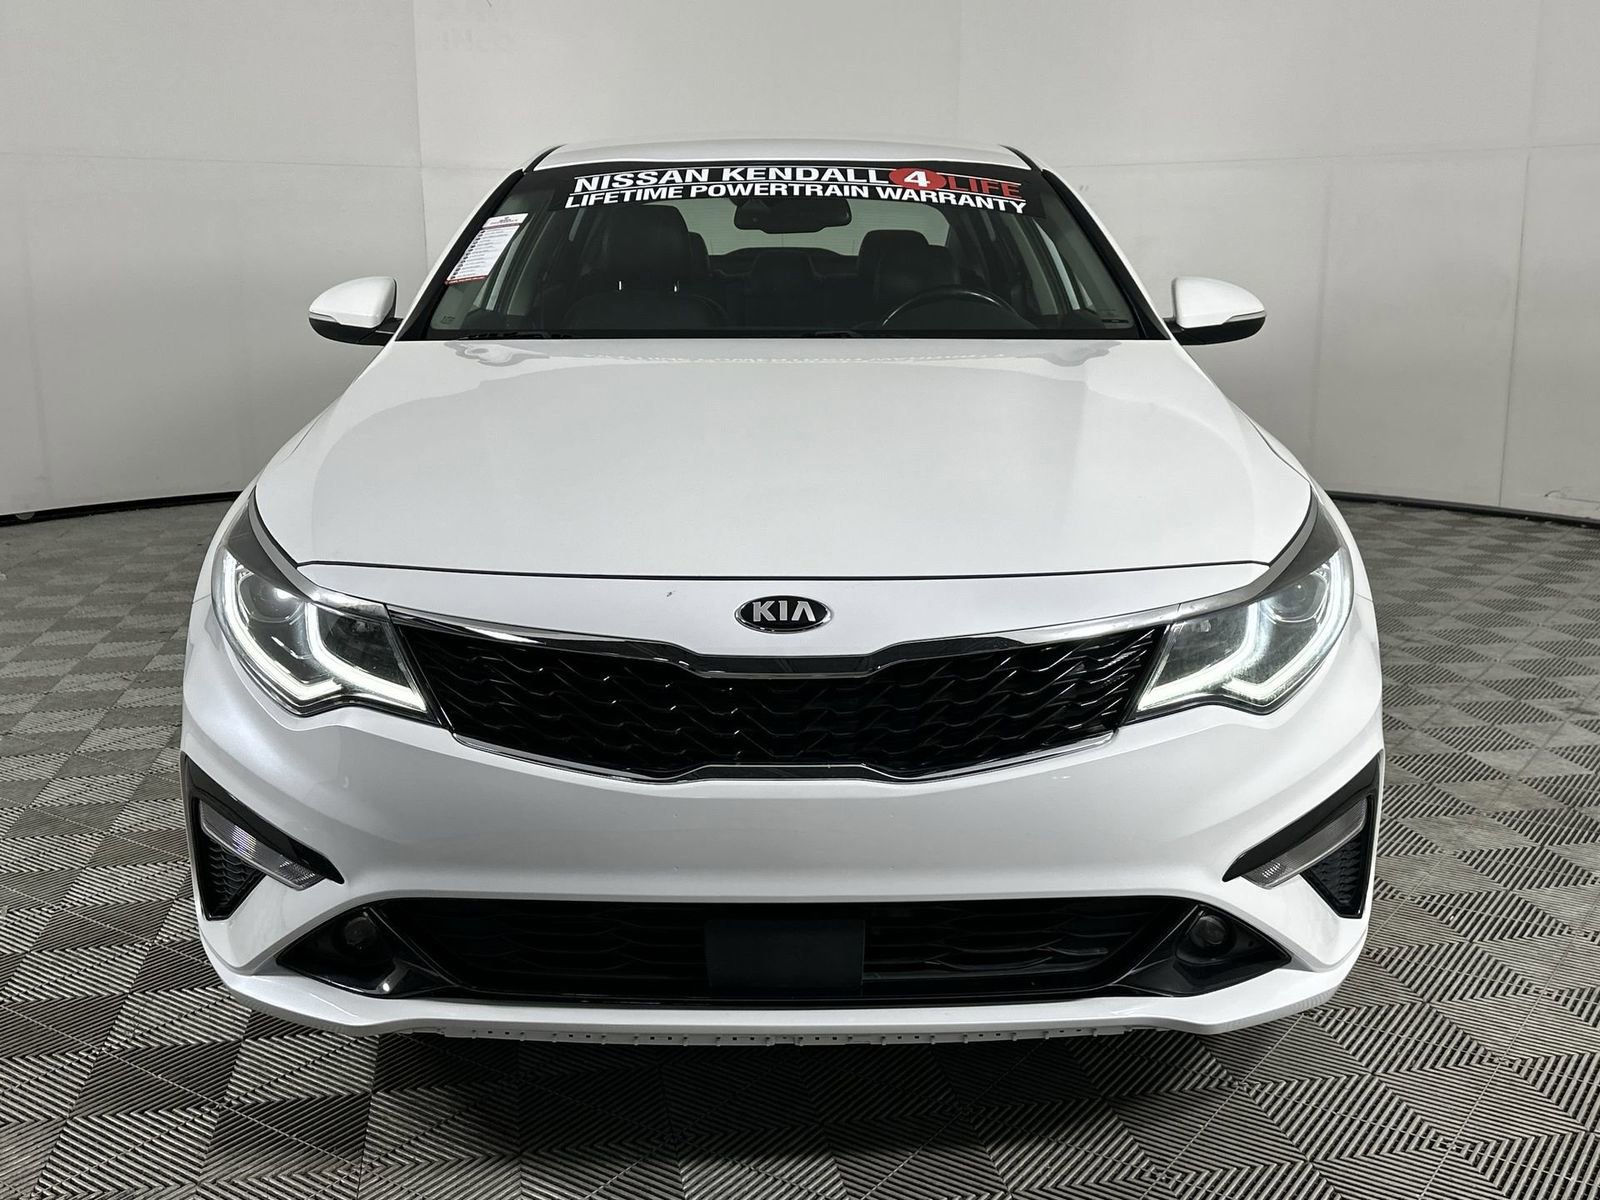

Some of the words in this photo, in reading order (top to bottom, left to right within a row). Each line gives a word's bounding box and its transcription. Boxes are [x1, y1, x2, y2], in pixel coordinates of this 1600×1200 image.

[574, 168, 709, 192] NISSAN
[722, 167, 889, 183] KENDALL
[904, 171, 930, 187] 4
[948, 177, 1022, 198] LIFE
[565, 186, 683, 209] LIFETIME
[690, 183, 869, 198] POWERTRAIN
[876, 187, 1026, 214] WARRANTY
[752, 600, 816, 622] KIA
